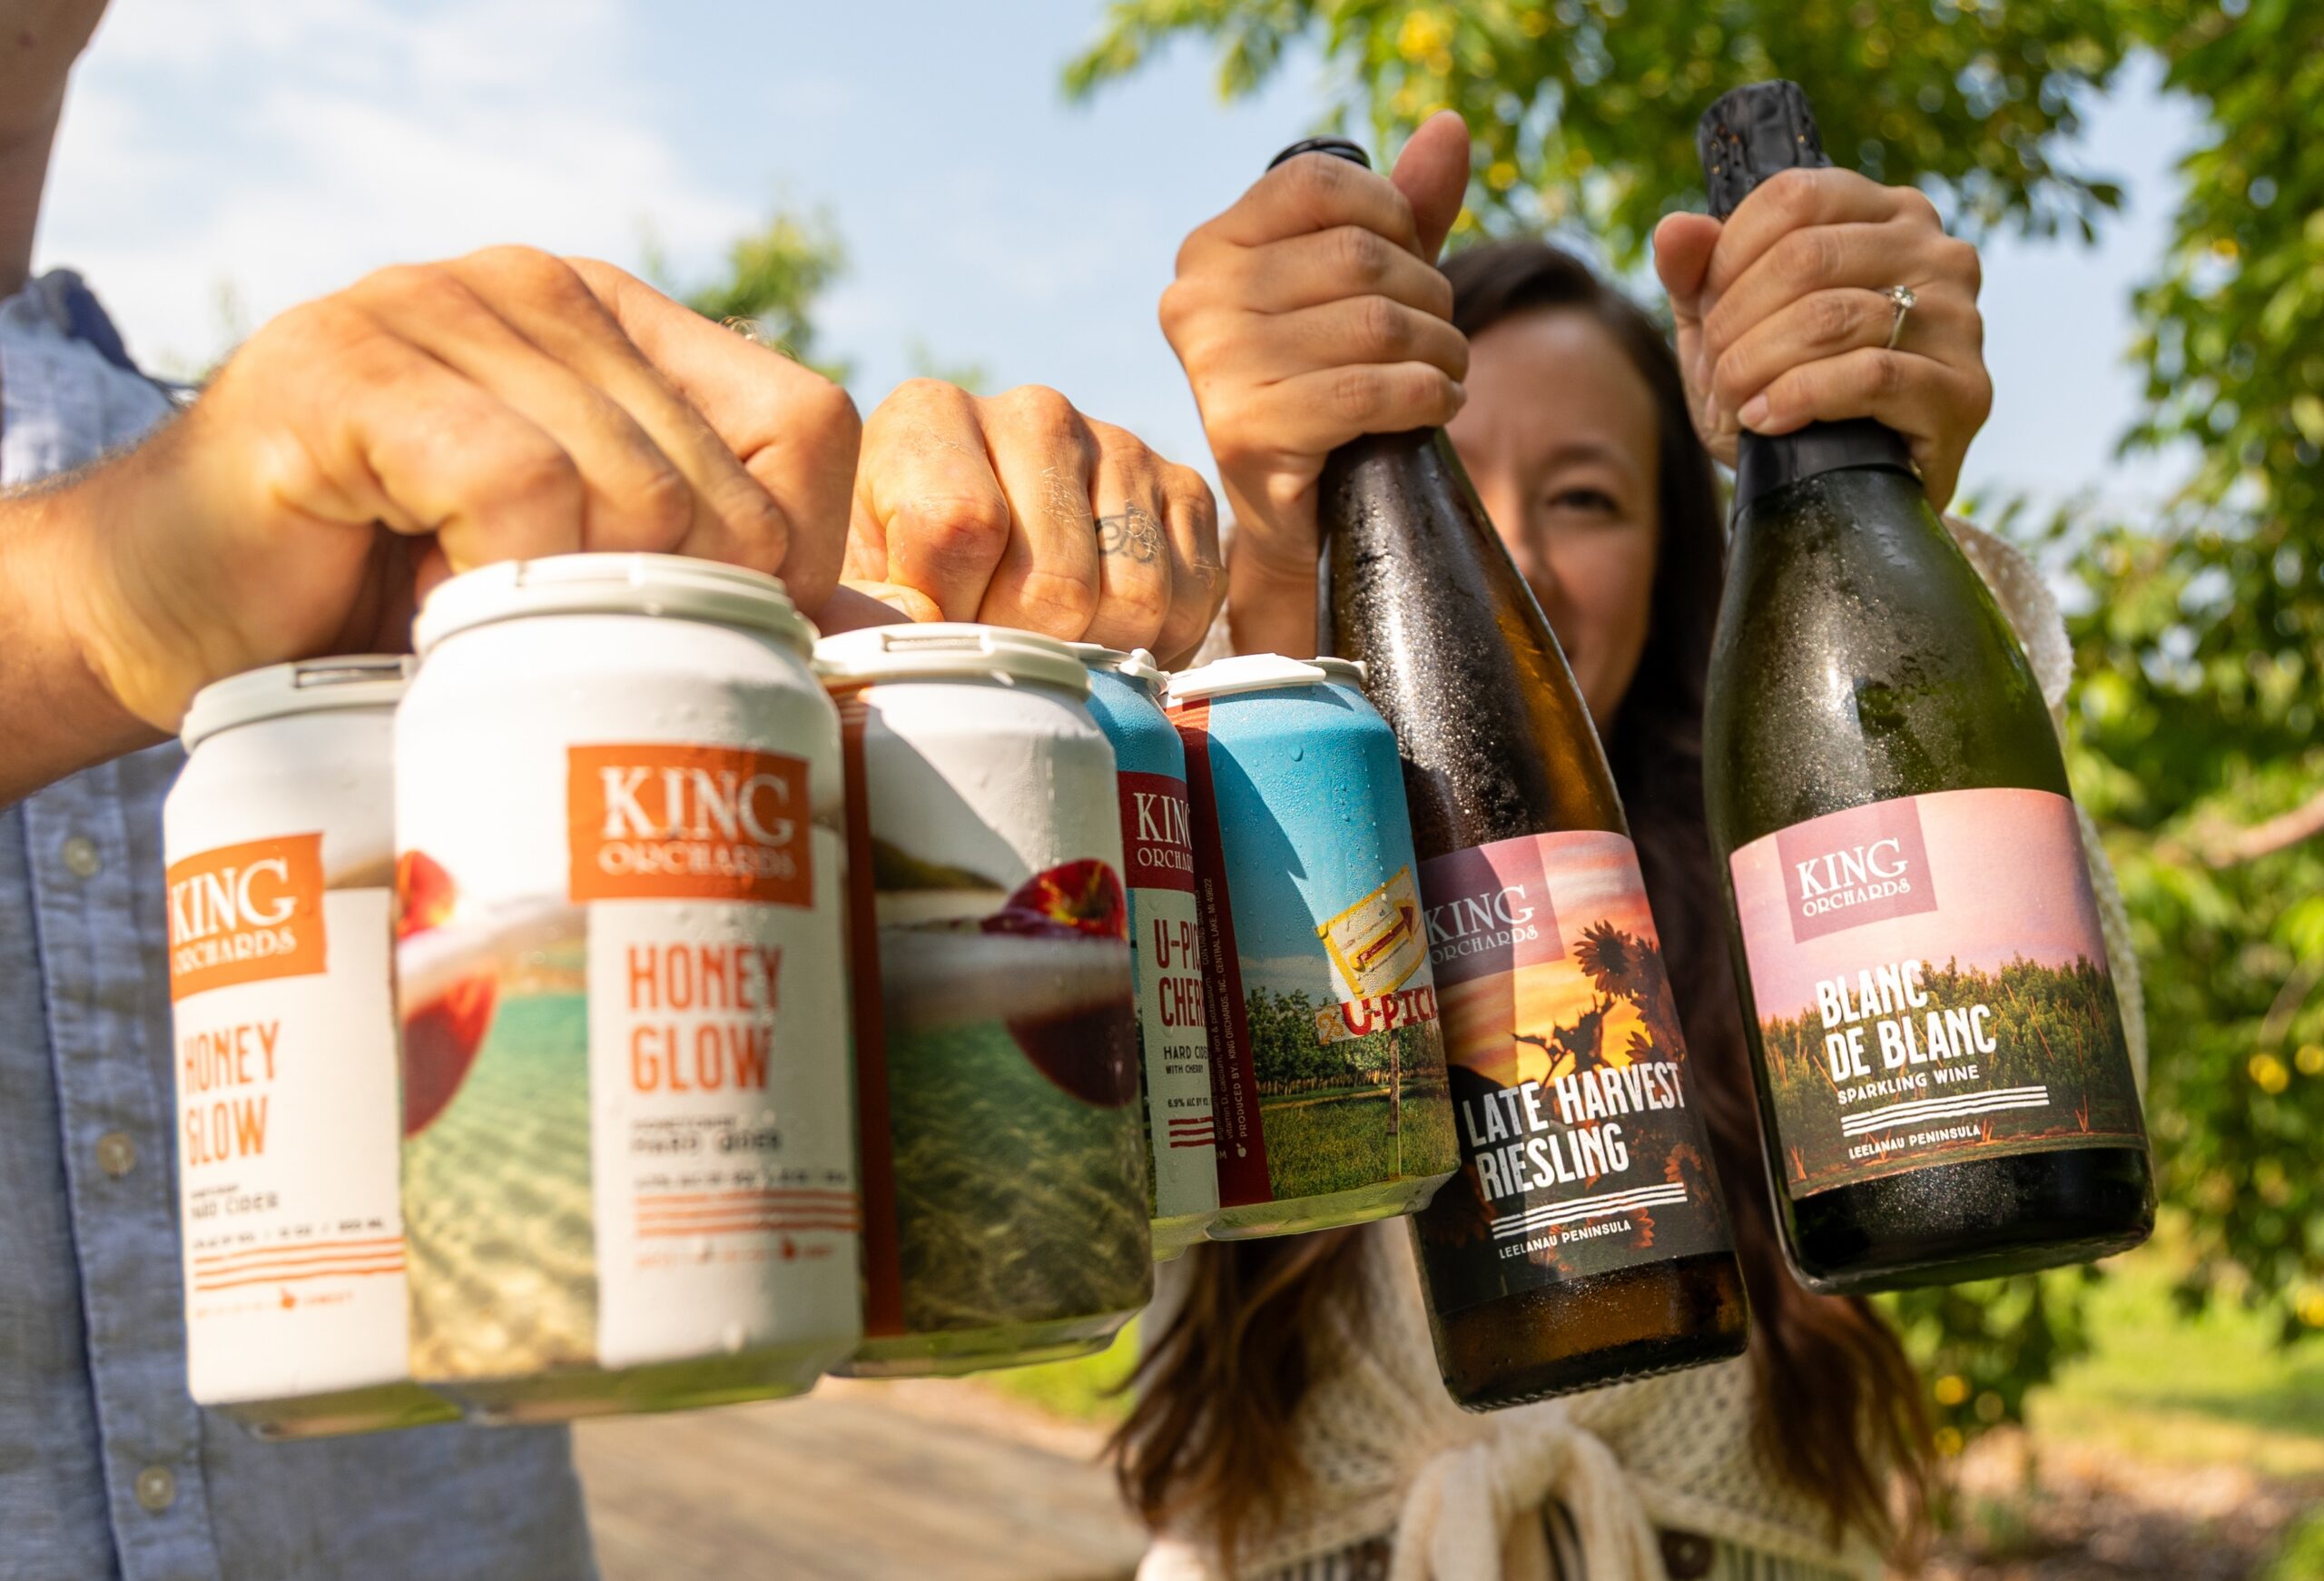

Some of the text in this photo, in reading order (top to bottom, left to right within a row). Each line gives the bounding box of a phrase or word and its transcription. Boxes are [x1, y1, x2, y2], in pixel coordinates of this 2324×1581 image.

[599, 765, 795, 848] KING
[596, 841, 797, 881] ORCHARDS
[1796, 836, 1909, 900] KING
[171, 855, 298, 946] KING
[1206, 904, 1216, 914] MI
[1423, 884, 1535, 944] KING
[1802, 878, 1911, 917] ORCHARDS
[1212, 937, 1225, 973] CENTRAL
[1430, 924, 1539, 964] ORCHARDS
[626, 942, 784, 1013] HONEY
[1816, 959, 1928, 1029] BLANC
[183, 1018, 280, 1095] HONEY
[629, 1023, 773, 1092] GLOW
[1163, 1045, 1192, 1060] HARD
[1166, 1064, 1183, 1074] WITH
[1226, 1040, 1236, 1060] KING
[1825, 1003, 1997, 1082] DE BLANC
[1234, 1082, 1247, 1138] PRODUCED
[1462, 1062, 1685, 1148] LATE HARVEST
[1837, 1064, 1980, 1105] SPARKLING WINE
[186, 1096, 269, 1168] GLOW
[1848, 1124, 1982, 1160] LEELANAU PENINSULA
[1475, 1122, 1630, 1201] RIESLING
[1499, 1220, 1631, 1260] LEELANAU PENINSULA
